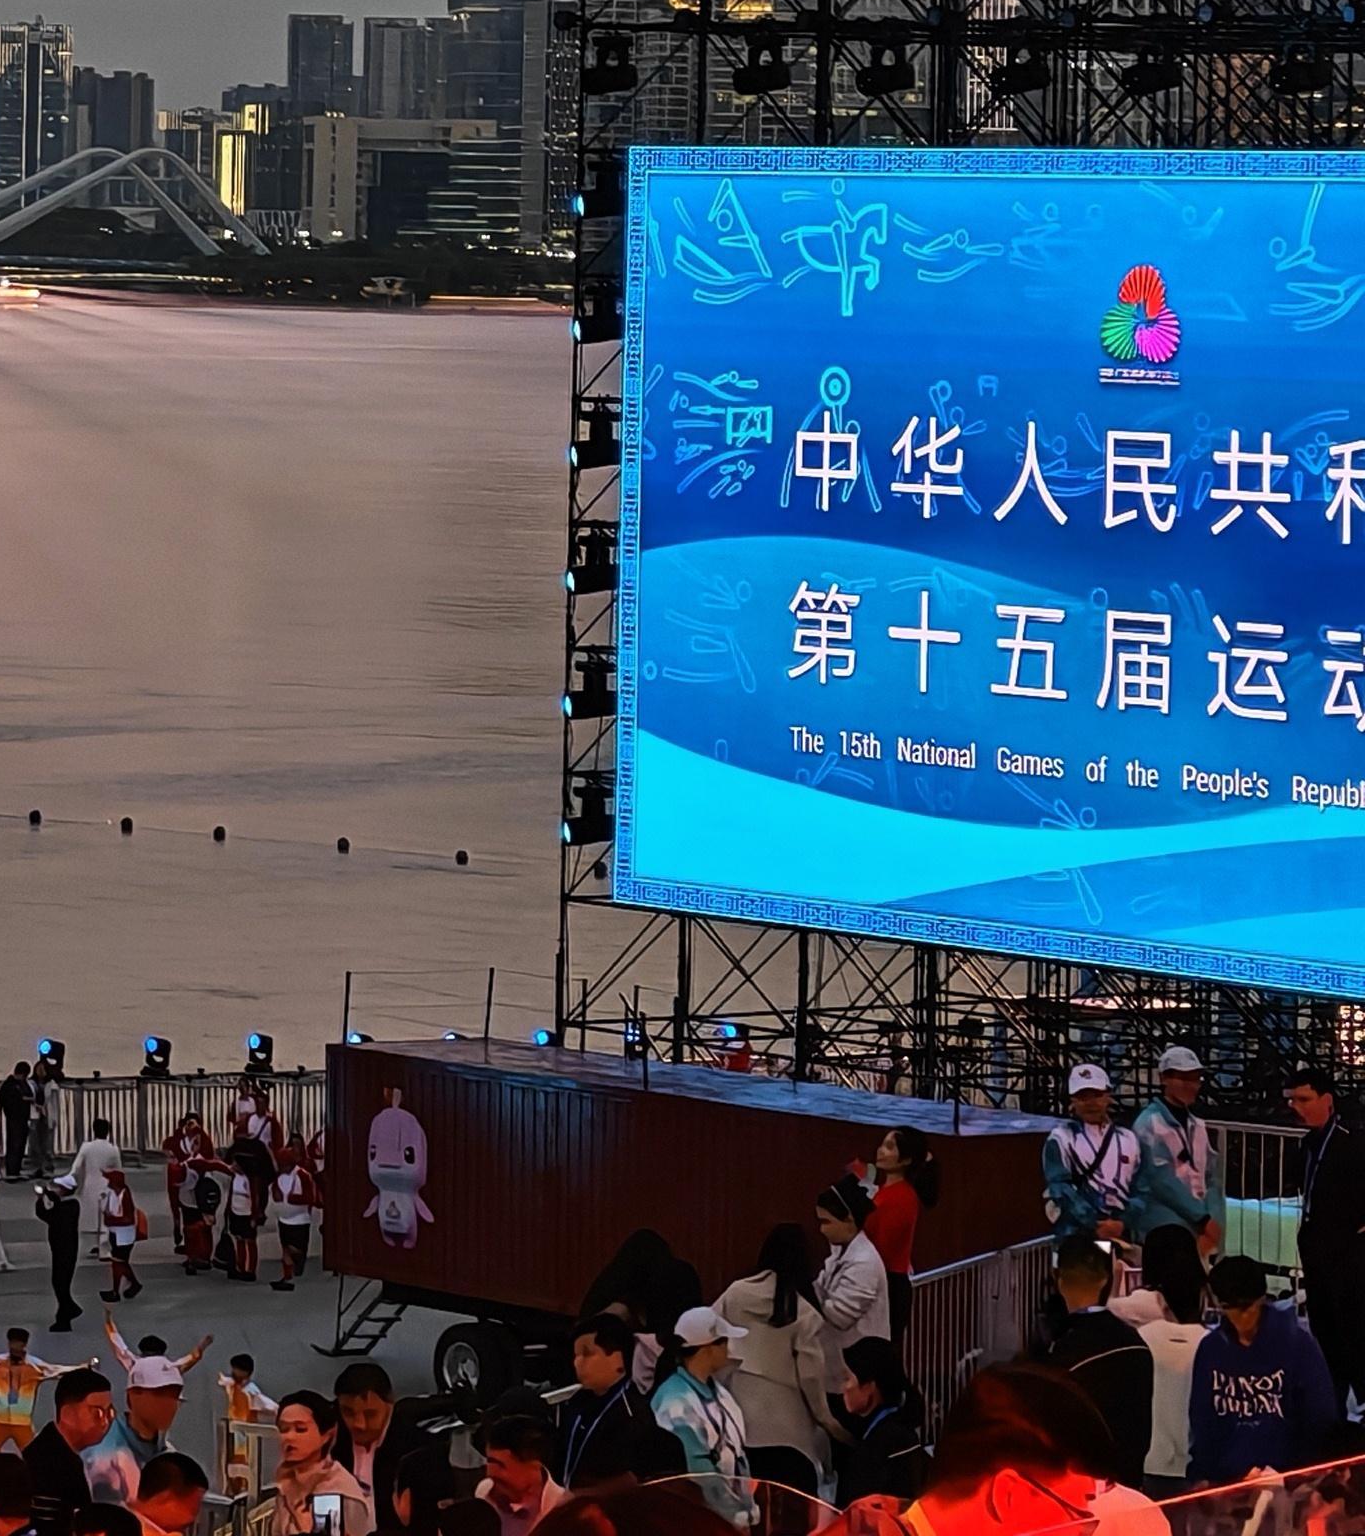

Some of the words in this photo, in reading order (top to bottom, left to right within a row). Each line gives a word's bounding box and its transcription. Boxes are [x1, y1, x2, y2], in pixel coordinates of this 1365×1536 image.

[789, 726, 825, 754] The
[839, 730, 881, 760] 15th
[897, 736, 976, 770] National
[997, 747, 1065, 779] Games
[1085, 755, 1108, 783] of
[1126, 759, 1159, 788] the
[1182, 764, 1269, 802] People's
